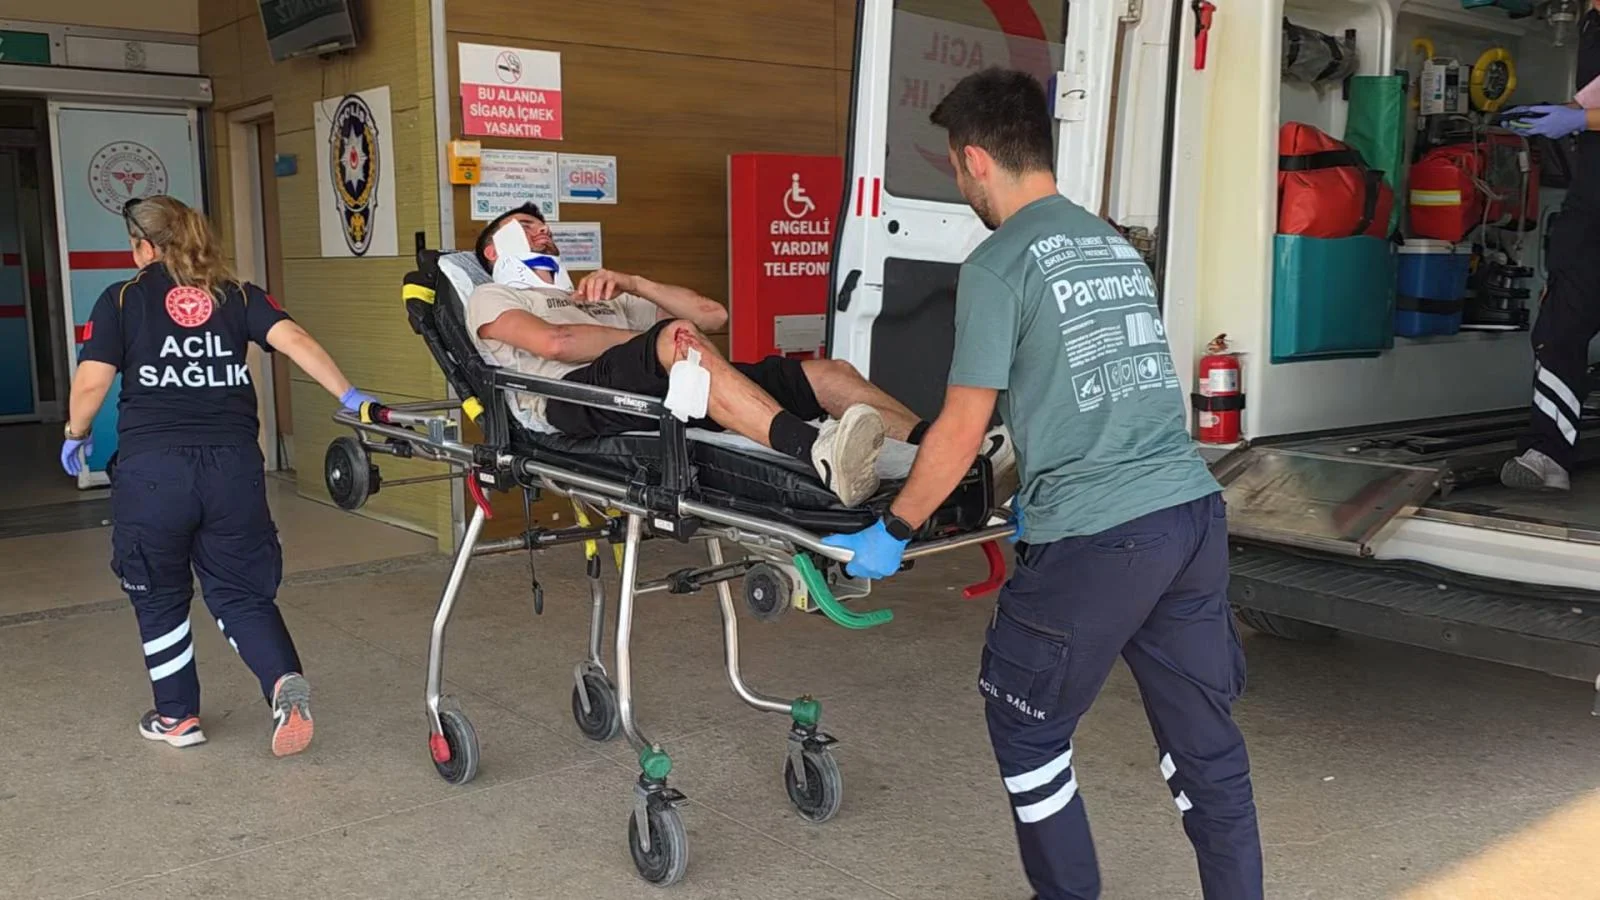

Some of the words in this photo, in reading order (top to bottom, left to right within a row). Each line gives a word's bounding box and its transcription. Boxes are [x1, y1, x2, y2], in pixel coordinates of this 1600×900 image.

[478, 87, 495, 101] BU
[497, 89, 546, 105] ALANDA
[470, 103, 516, 119] SİGARA
[517, 106, 554, 122] İÇMEK
[484, 121, 542, 137] YASAKTIR
[569, 168, 606, 187] GİRİŞ
[770, 217, 830, 235] ENGELLİ
[771, 241, 829, 256] YARDIM
[1030, 234, 1074, 258] 100%
[1044, 250, 1077, 267] SKILLED
[1052, 269, 1155, 314] Paramedic
[160, 331, 233, 358] ACİL
[139, 361, 250, 387] SAĞLIK
[979, 678, 999, 697] ACİL
[1006, 694, 1046, 720] SAĞLIK
